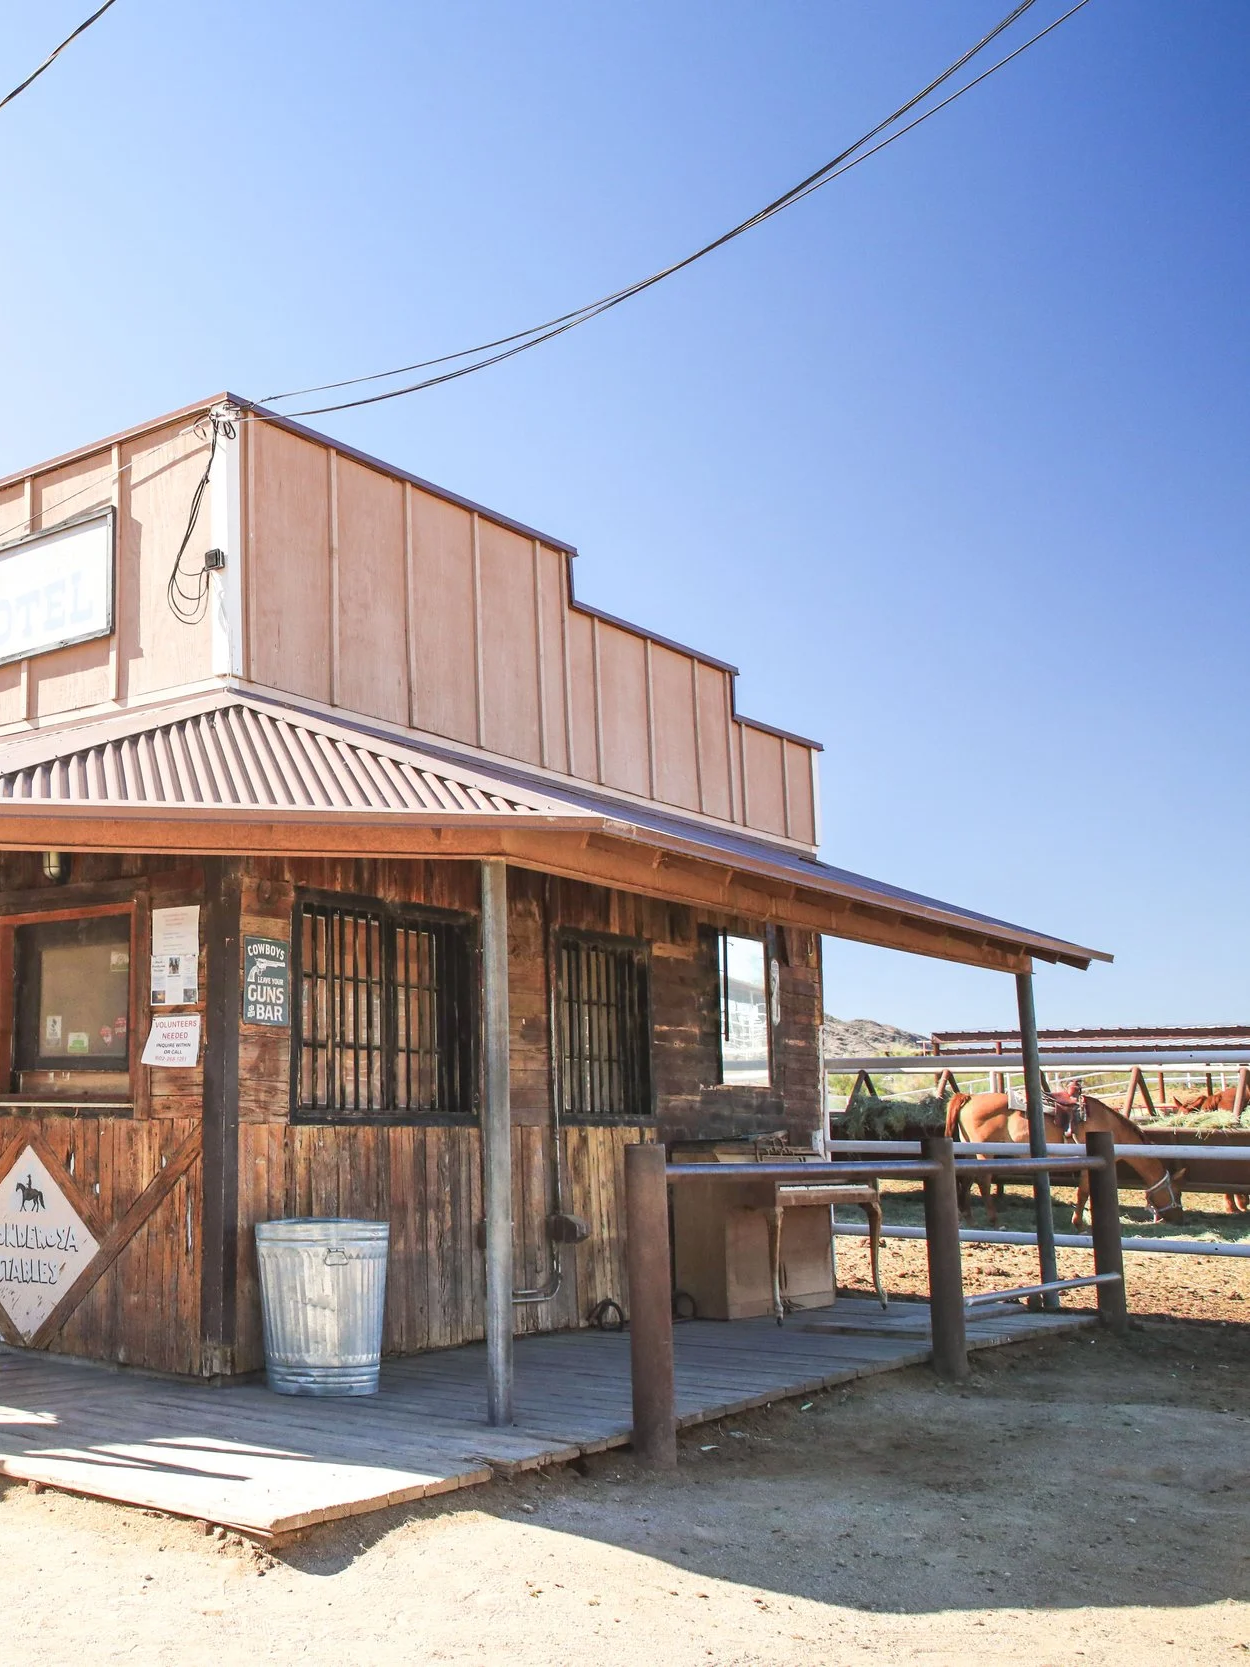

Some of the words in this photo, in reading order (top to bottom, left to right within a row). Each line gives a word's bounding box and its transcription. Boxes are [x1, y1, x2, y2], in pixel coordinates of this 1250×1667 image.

[247, 943, 285, 961] COWBOYS
[257, 976, 271, 985] LEAVE
[247, 984, 285, 1005] GUNS
[256, 1003, 283, 1022] BAR
[155, 1019, 198, 1029] VOLUNTEERS
[161, 1031, 189, 1040] NEEDED
